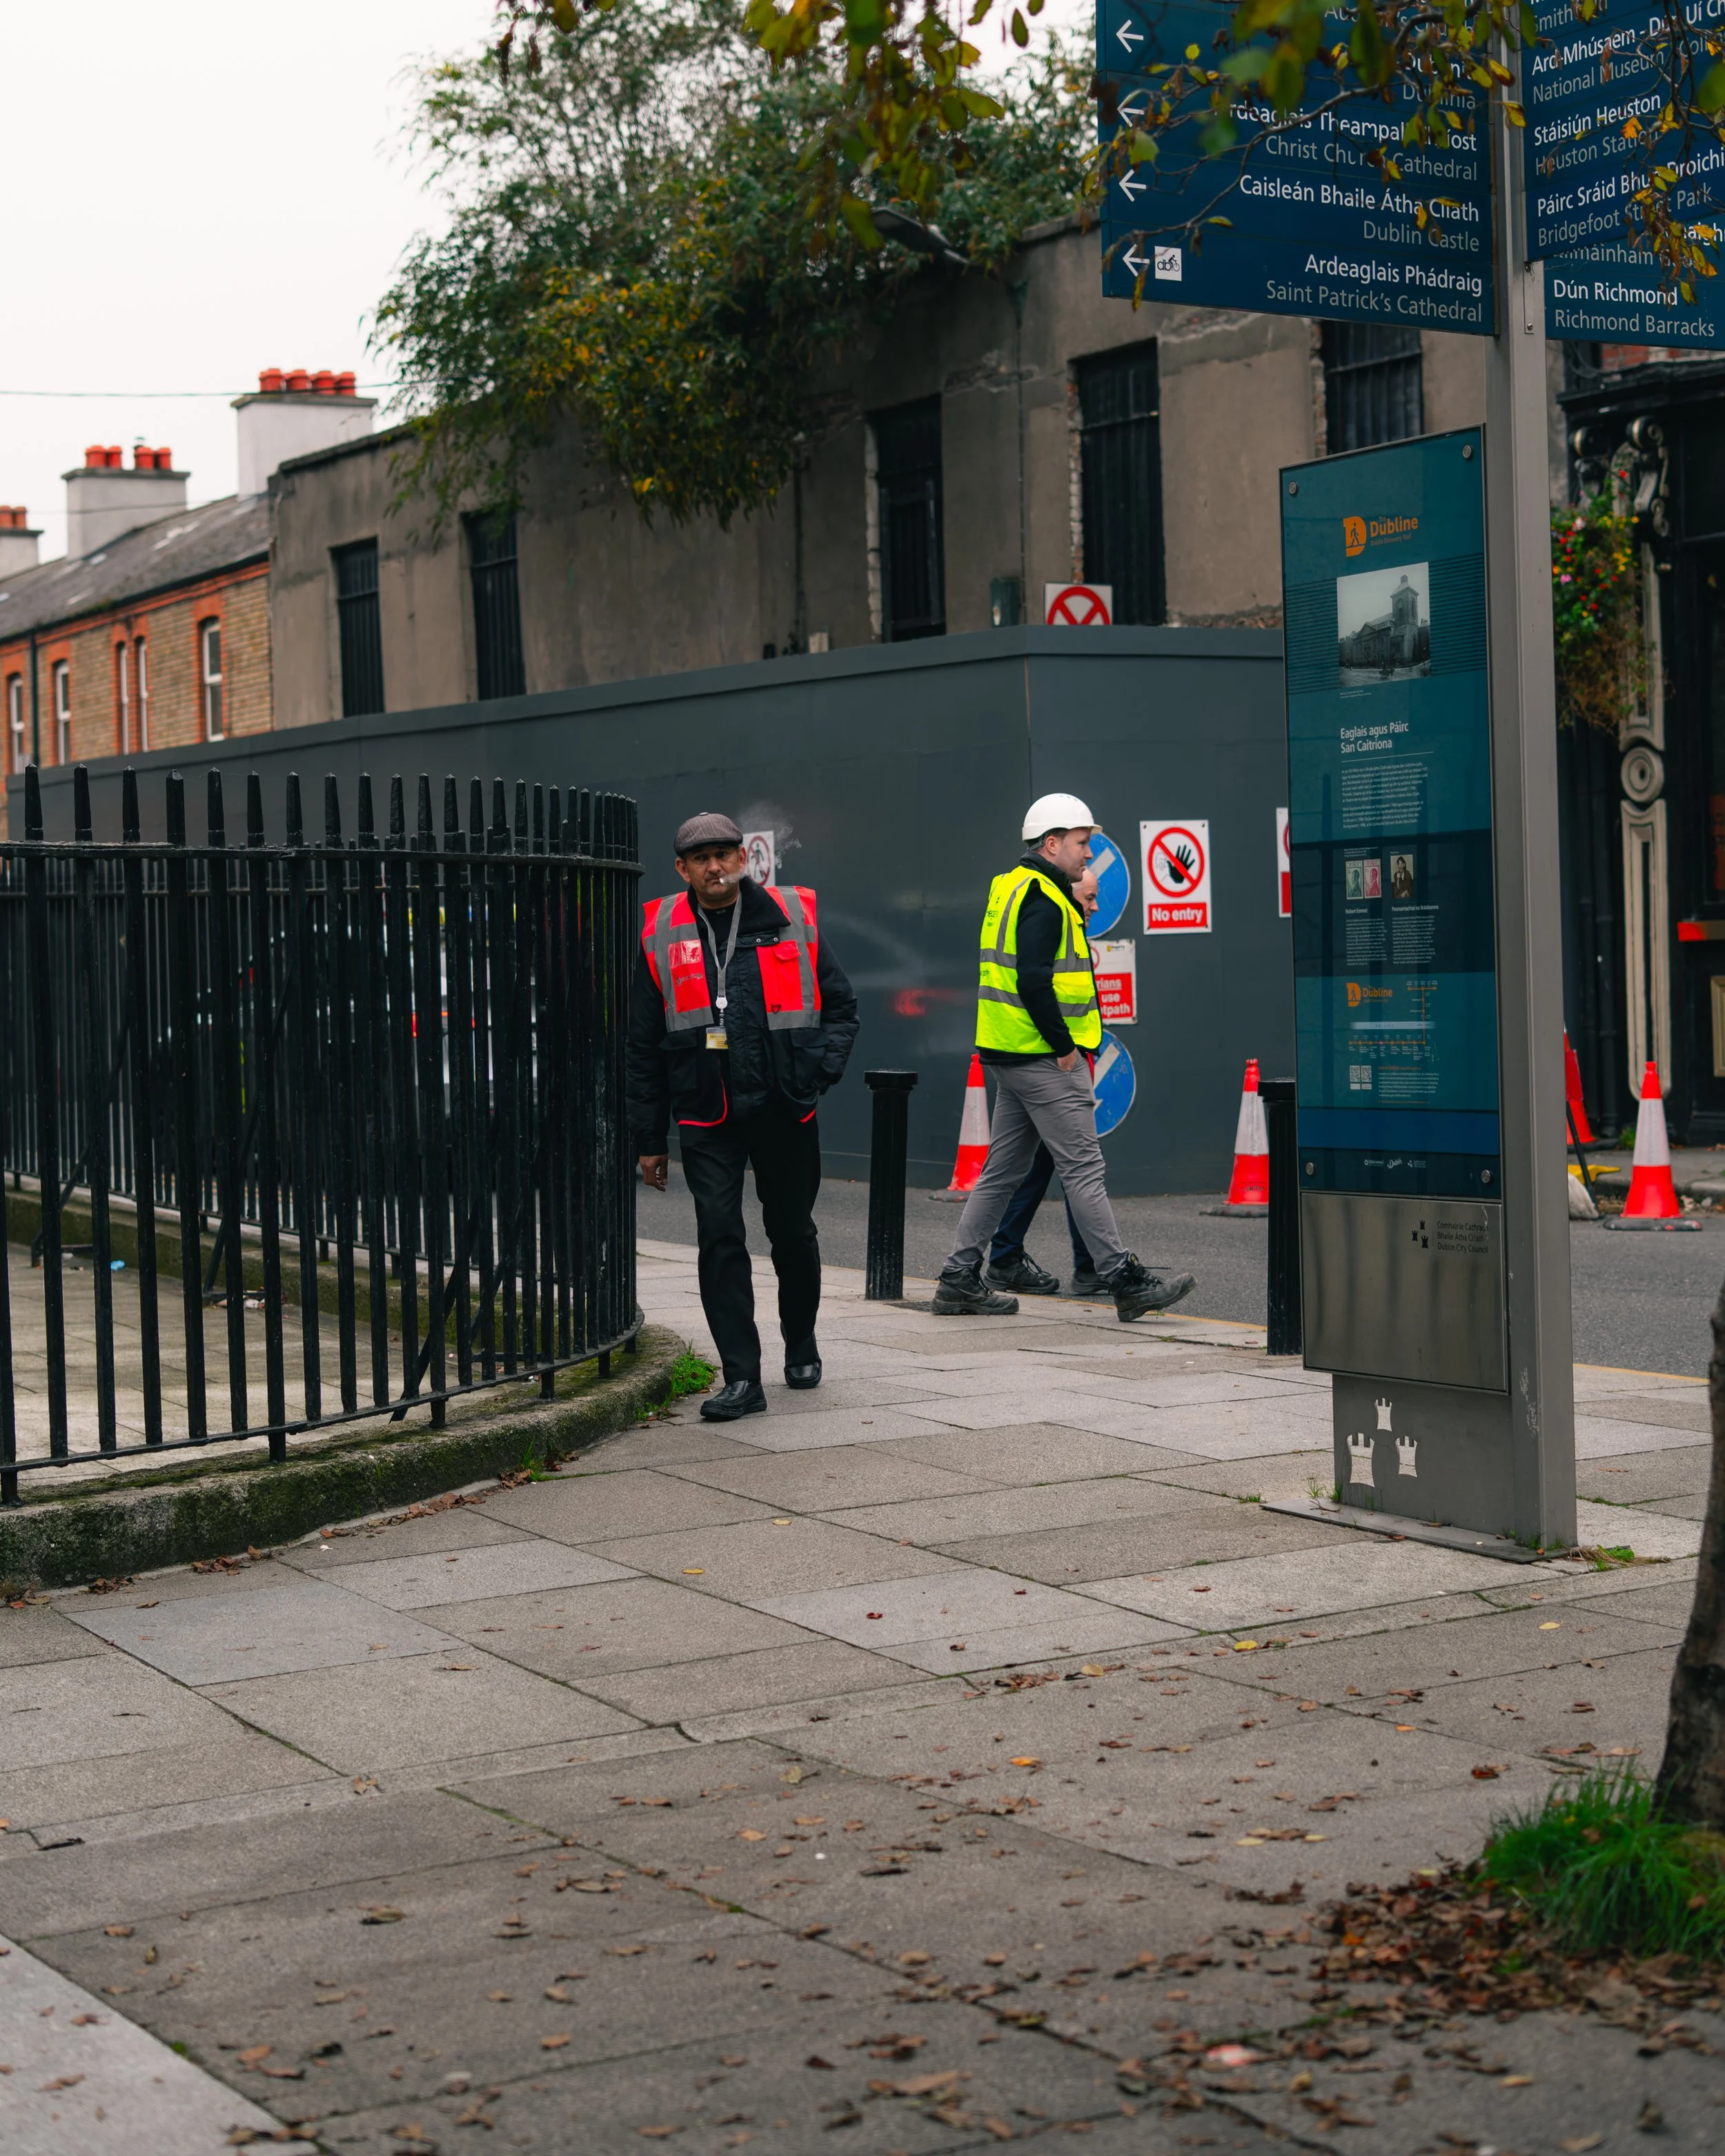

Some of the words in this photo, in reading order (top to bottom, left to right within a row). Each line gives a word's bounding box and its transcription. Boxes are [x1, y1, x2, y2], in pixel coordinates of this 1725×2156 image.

[1686, 0, 1702, 24] Uí
[1532, 66, 1595, 105] National
[1216, 100, 1312, 129] rdeaglais
[1534, 113, 1592, 147] Stáisiún
[1596, 94, 1661, 128] Heuston
[1265, 135, 1318, 160] Christ
[1392, 152, 1477, 181] Cathedral
[1535, 144, 1597, 176] Heuston
[1240, 175, 1314, 202] Caisleán
[1321, 184, 1375, 210] Bhaile
[1537, 194, 1574, 217] Páirc
[1577, 177, 1616, 207] Sráid
[1363, 220, 1421, 245] Dublin
[1428, 228, 1479, 251] Castle
[1538, 209, 1621, 247] Bridgefoot
[1304, 254, 1399, 284] Ardeaglais
[1405, 265, 1482, 297] Phádraig
[1266, 279, 1312, 304] Saint
[1319, 286, 1391, 311] Patrick's
[1397, 295, 1481, 322] Cathedral
[1553, 279, 1589, 299] Dún
[1594, 281, 1678, 306] Richmond
[1555, 309, 1639, 332] Richmond
[1646, 315, 1715, 337] Barracks
[1370, 516, 1419, 537] Dubline
[1340, 725, 1368, 741] Eaglais
[1369, 725, 1388, 738] agus
[1390, 720, 1409, 733] Páirc
[1341, 742, 1355, 753] San
[1357, 738, 1392, 751] Caitríona
[1152, 907, 1170, 922] No
[1172, 907, 1203, 924] entry
[1101, 992, 1121, 1003] use
[1363, 987, 1392, 998] Dubline
[1437, 1242, 1455, 1251] Dublin
